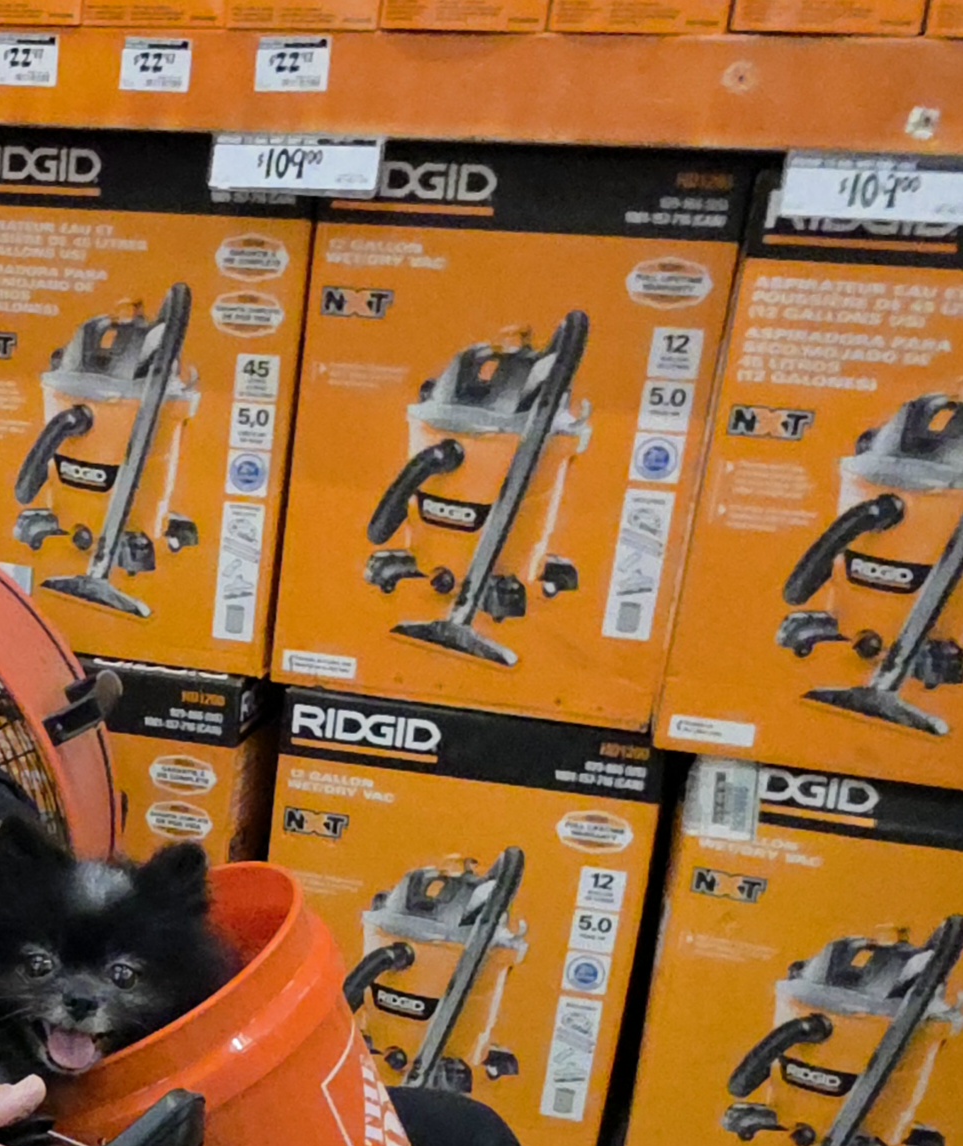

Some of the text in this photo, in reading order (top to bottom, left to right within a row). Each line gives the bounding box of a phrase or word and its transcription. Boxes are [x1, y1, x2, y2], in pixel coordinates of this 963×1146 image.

[321, 286, 394, 319] NXT
[664, 334, 690, 354] 12
[243, 359, 270, 378] 45
[649, 387, 686, 407] 5.0
[237, 408, 269, 429] 5,0
[728, 404, 815, 440] NXT
[291, 703, 442, 752] RIDGID
[283, 806, 350, 840] NXT
[589, 873, 615, 891] 12
[691, 866, 768, 903] NXT
[578, 914, 614, 934] 5.0
[786, 1063, 841, 1089] RIDGID
